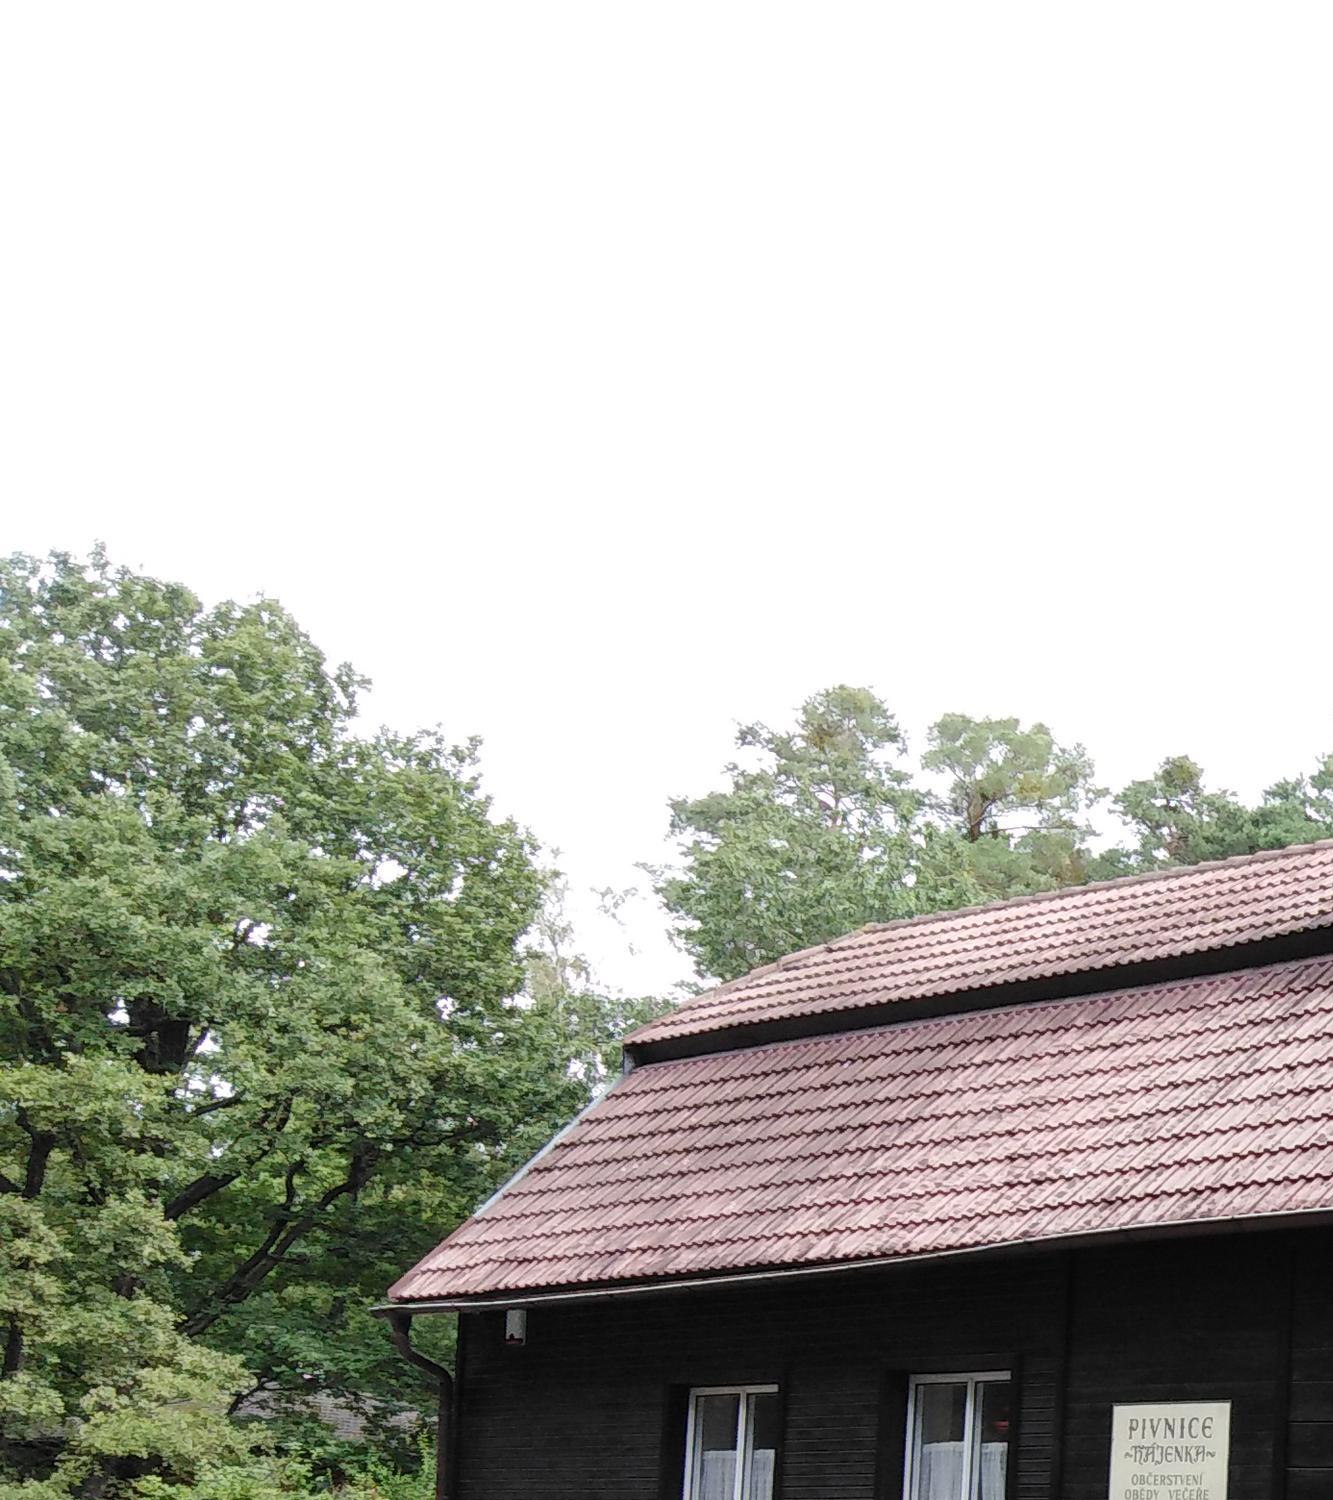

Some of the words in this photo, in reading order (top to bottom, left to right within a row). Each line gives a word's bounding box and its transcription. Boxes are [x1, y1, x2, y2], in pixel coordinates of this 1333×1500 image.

[1128, 1416, 1214, 1440] PIVNICE
[1131, 1472, 1204, 1487] OBČERSTVENÍ
[1124, 1488, 1160, 1500] OBĚDY
[1168, 1487, 1210, 1500] VEČEŘE
